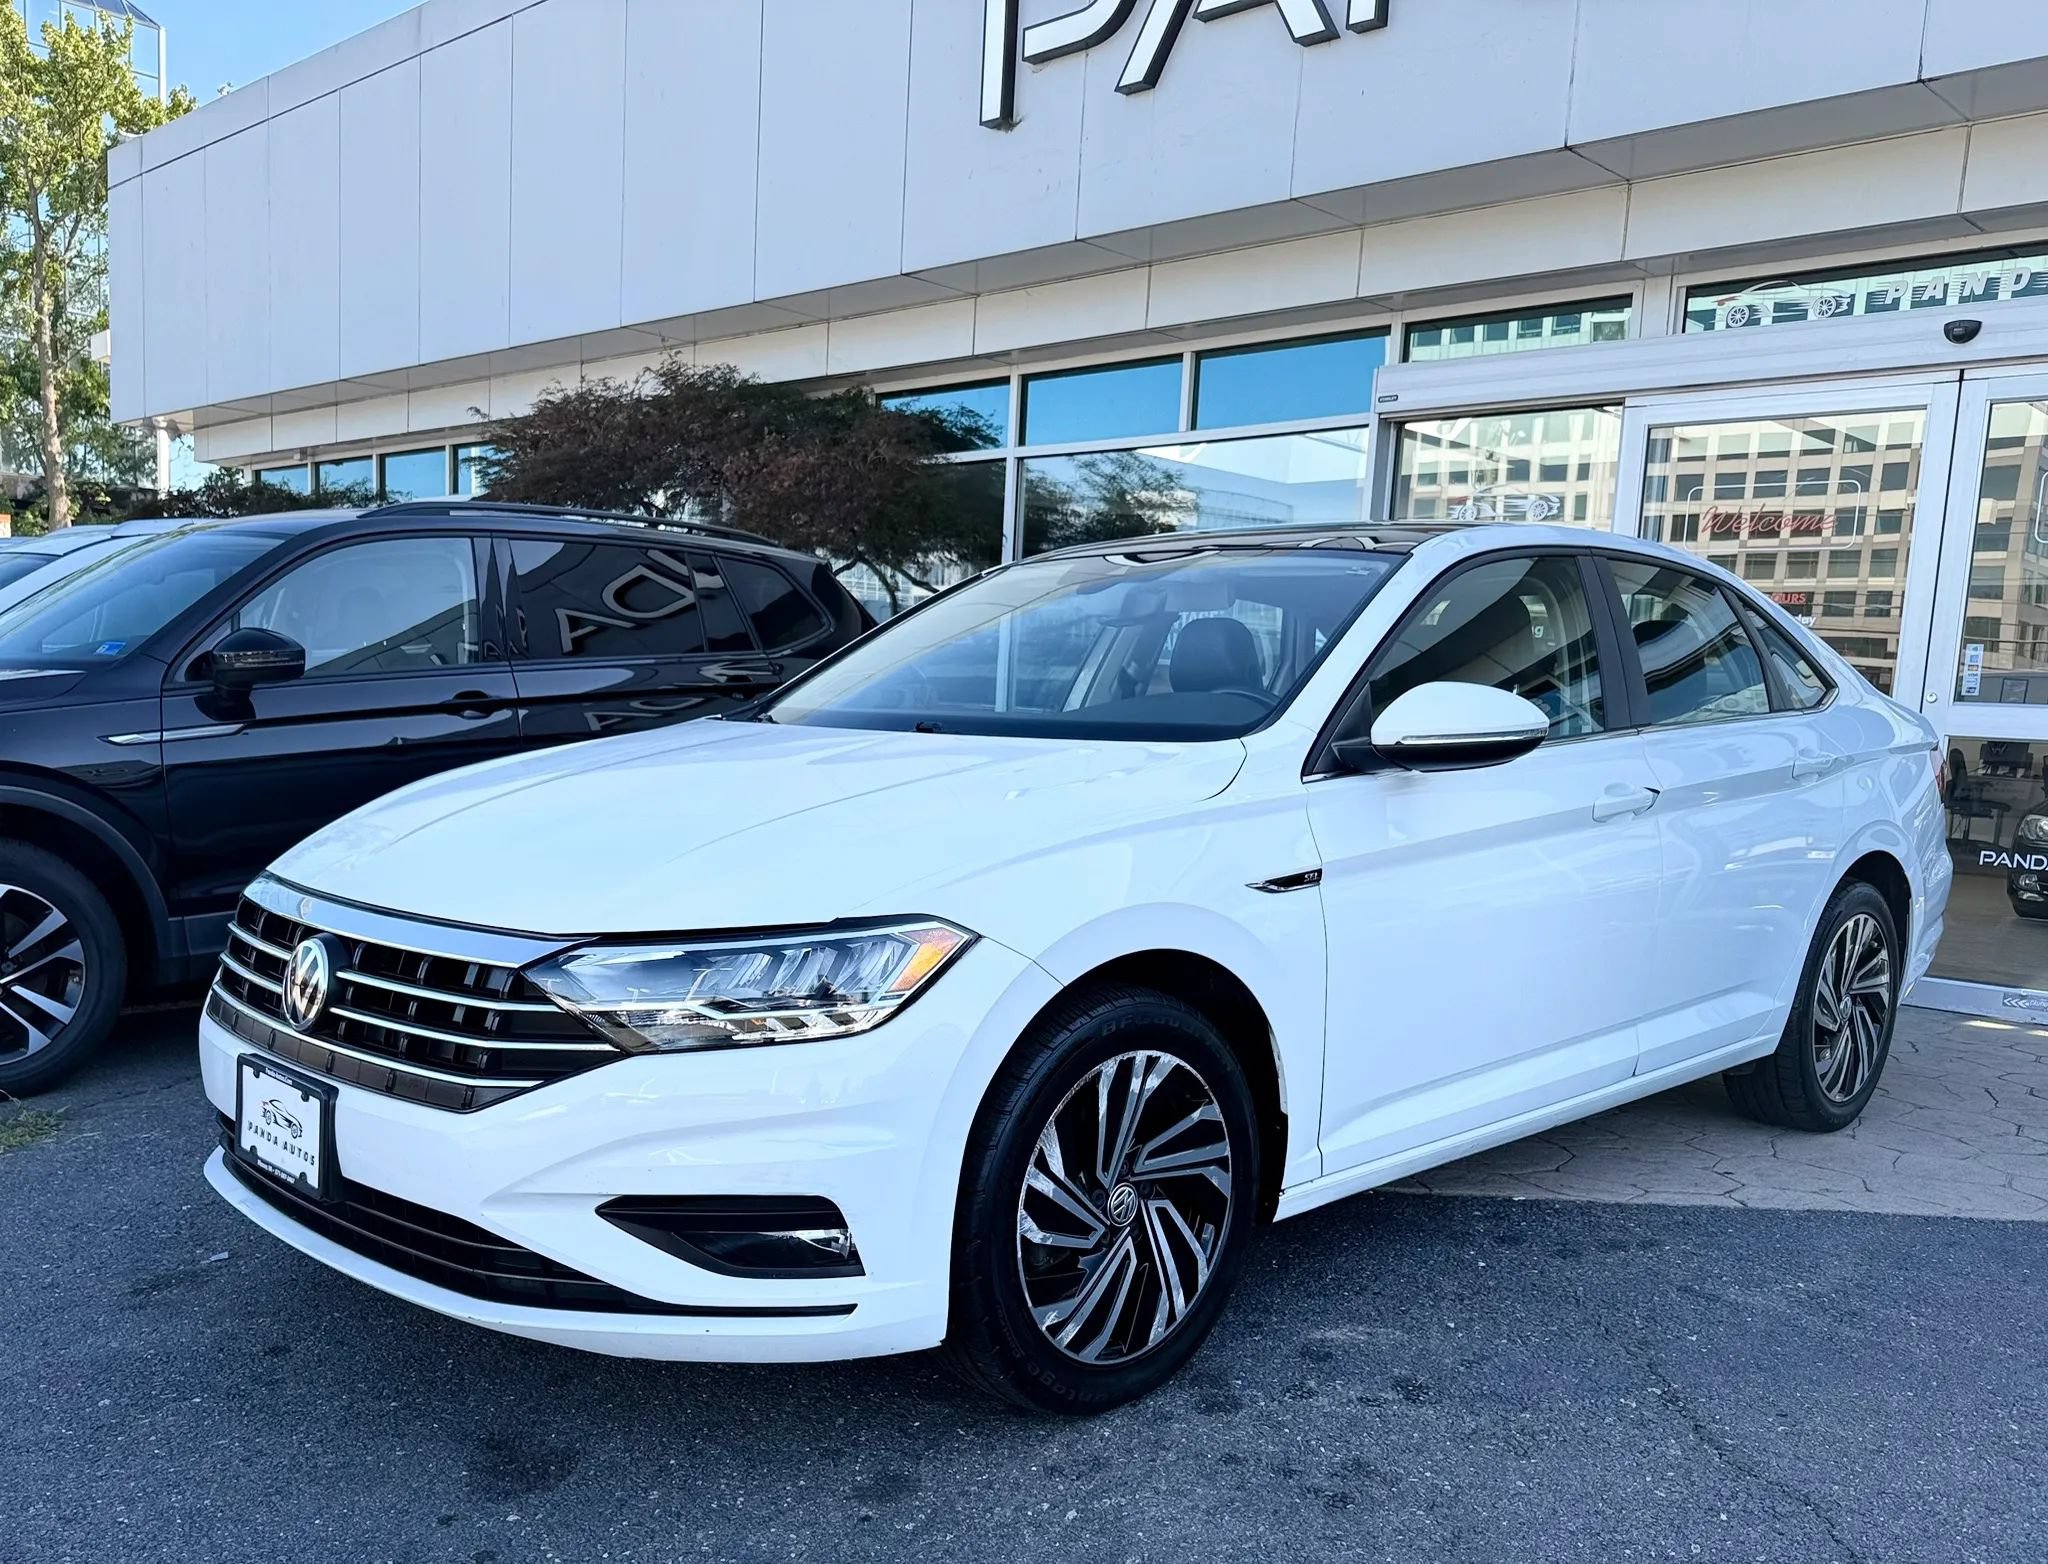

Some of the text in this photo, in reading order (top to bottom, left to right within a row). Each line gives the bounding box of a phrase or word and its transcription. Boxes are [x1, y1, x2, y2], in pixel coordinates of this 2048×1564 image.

[1701, 503, 1837, 534] Welcome
[1768, 592, 1807, 604] OURS
[1979, 850, 2048, 871] PAND
[247, 1120, 315, 1166] PANDA AUTOS
